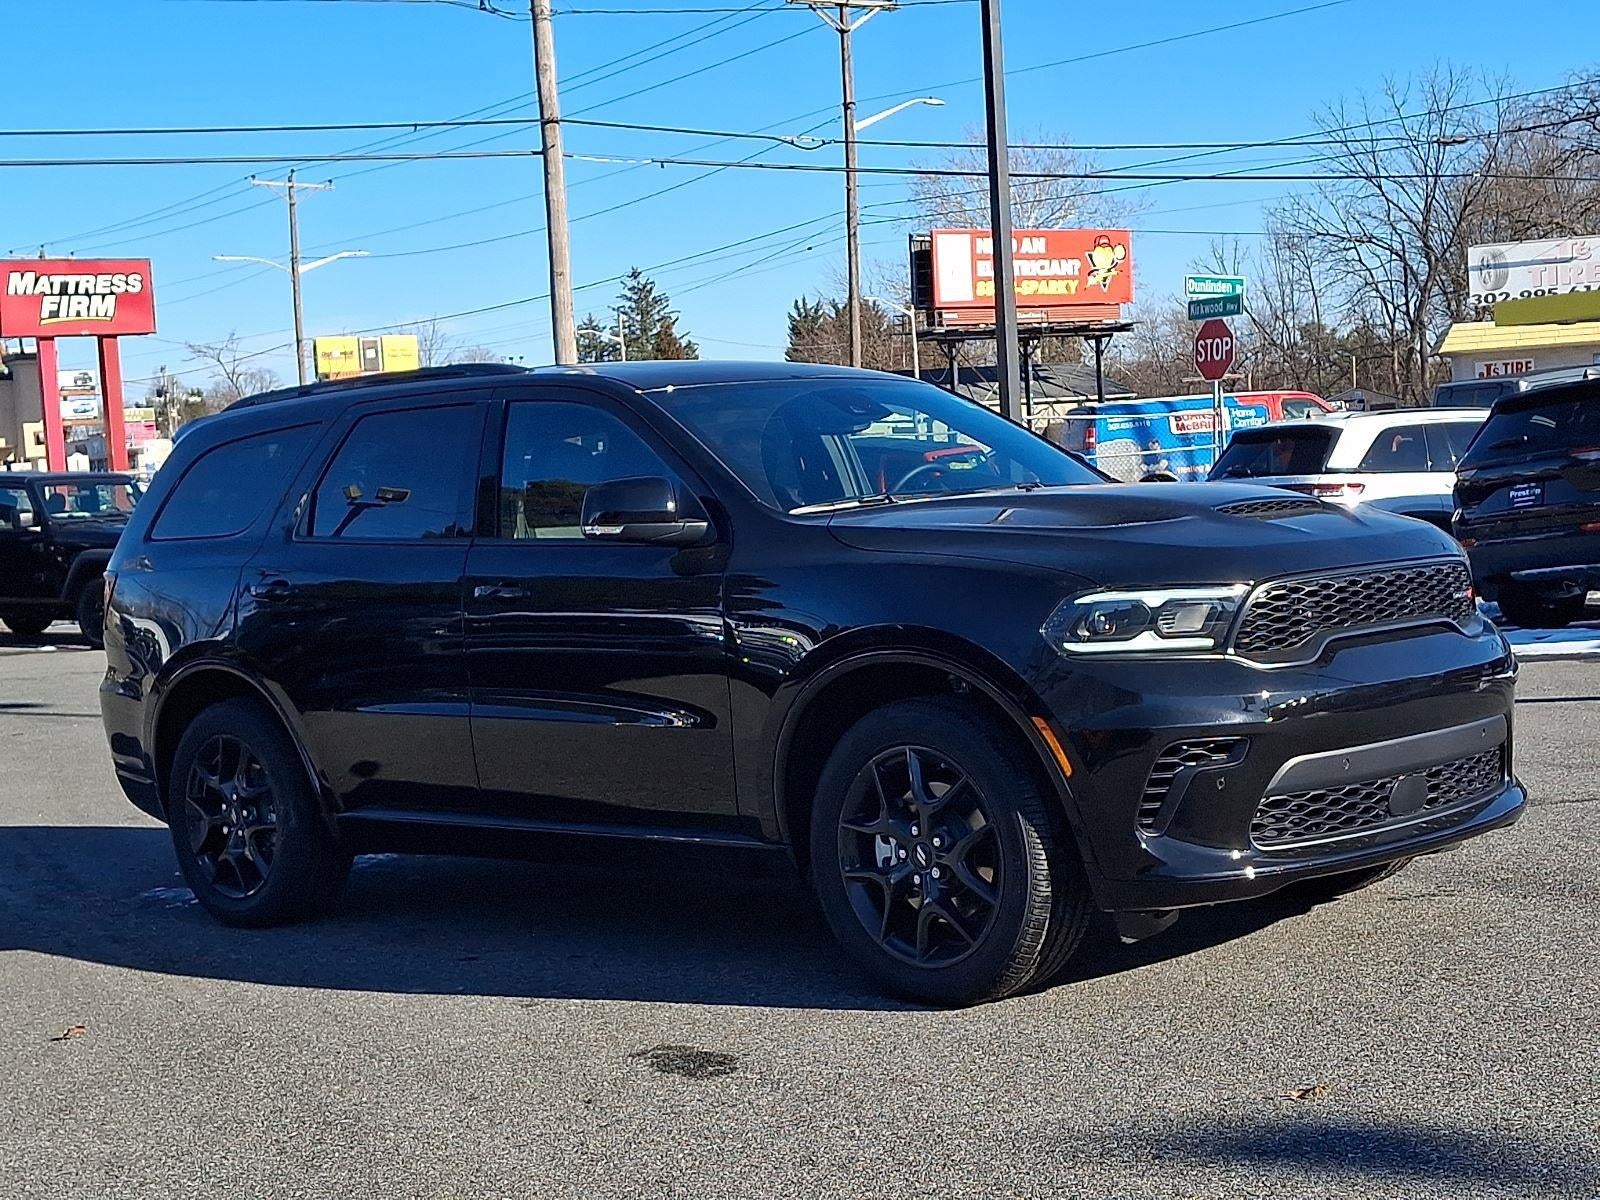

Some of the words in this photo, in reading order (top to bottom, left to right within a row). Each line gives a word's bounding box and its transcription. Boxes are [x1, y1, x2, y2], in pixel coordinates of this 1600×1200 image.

[1020, 237, 1047, 254] AN
[976, 258, 1082, 277] ELTRICIAN?
[1527, 262, 1600, 289] TIRE
[7, 270, 144, 296] MATTRESS
[1188, 278, 1232, 293] Dunlinden
[40, 294, 117, 319] FIRM
[1190, 300, 1223, 315] Kirkwood
[1197, 336, 1232, 362] STOP
[1502, 360, 1533, 374] TIRE
[1230, 406, 1256, 418] Home
[1233, 414, 1266, 428] Comfort
